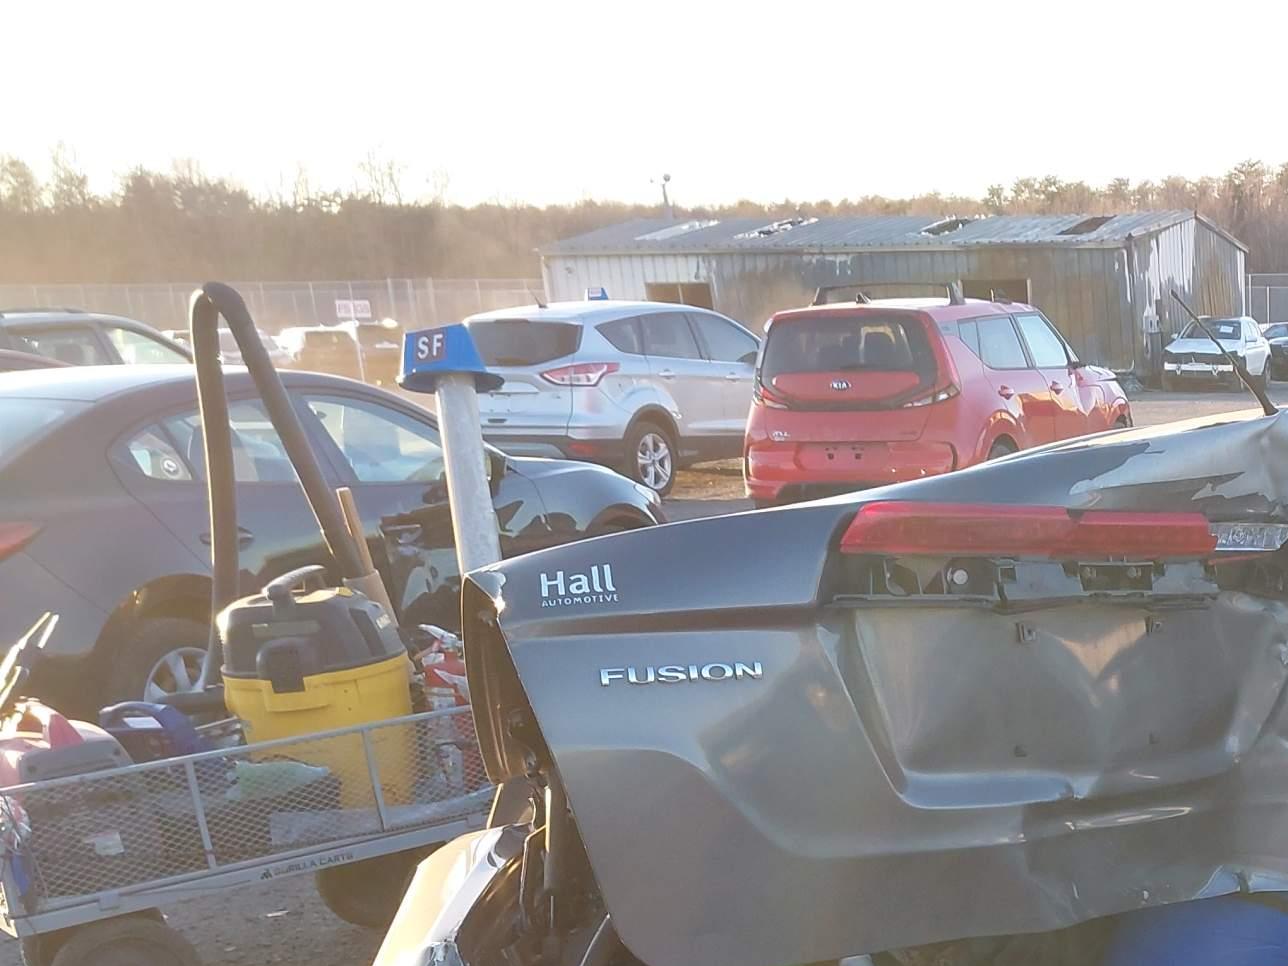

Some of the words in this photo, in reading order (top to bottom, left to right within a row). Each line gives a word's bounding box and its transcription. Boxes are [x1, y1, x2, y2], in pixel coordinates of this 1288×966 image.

[418, 333, 443, 360] SF
[540, 563, 617, 597] Hall
[542, 593, 620, 608] AUTOMOTIVE
[600, 662, 763, 687] FUSION
